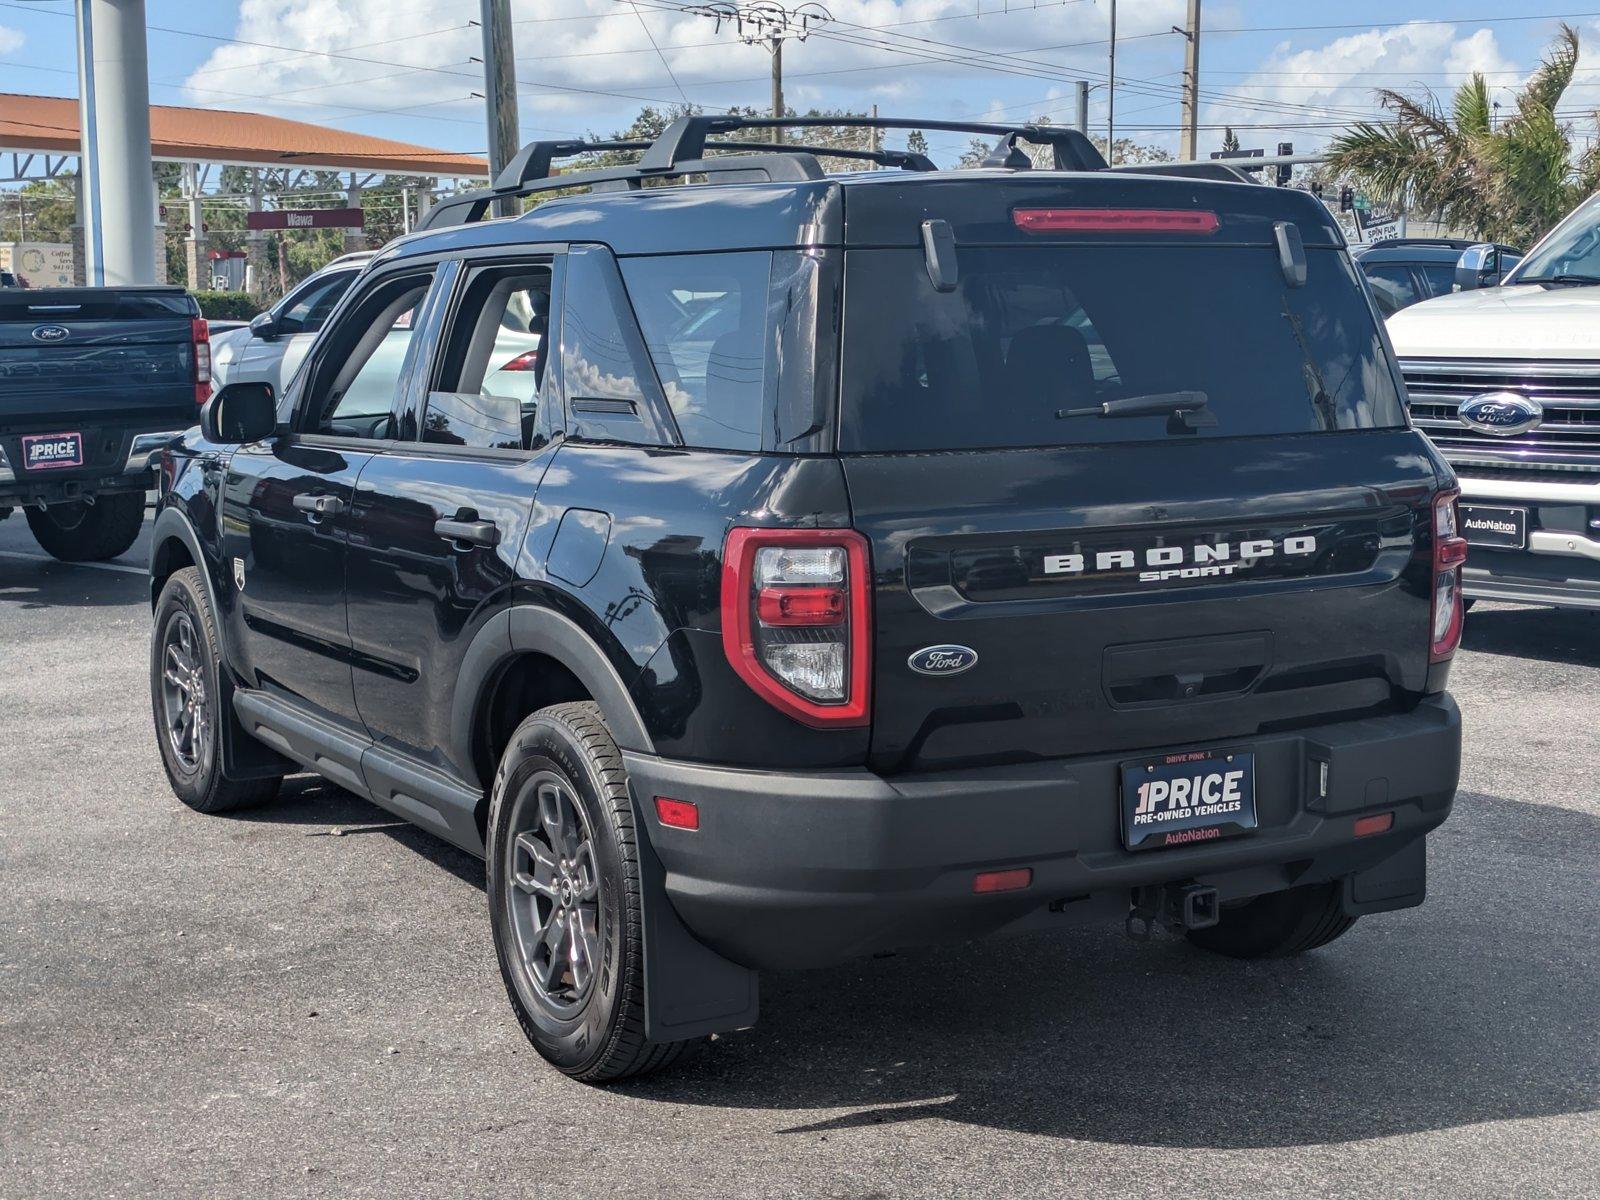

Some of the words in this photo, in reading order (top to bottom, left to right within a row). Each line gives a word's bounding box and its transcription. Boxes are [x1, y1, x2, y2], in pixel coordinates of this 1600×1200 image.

[287, 213, 314, 227] Wawa
[1368, 227, 1383, 239] SPIN
[1384, 224, 1396, 235] FUN
[30, 441, 76, 457] 1PRICE
[1464, 518, 1517, 532] AutoNation
[1043, 535, 1317, 574] BRONCO
[1139, 564, 1238, 582] SPORT
[925, 651, 963, 669] Ford
[1166, 754, 1187, 764] DRIVE
[1188, 751, 1205, 761] PINK
[1135, 770, 1244, 814] 1PRICE
[1133, 808, 1192, 825] PRE-OWNED
[1194, 801, 1241, 816] VEHICLES
[1164, 827, 1220, 845] AutoNation
